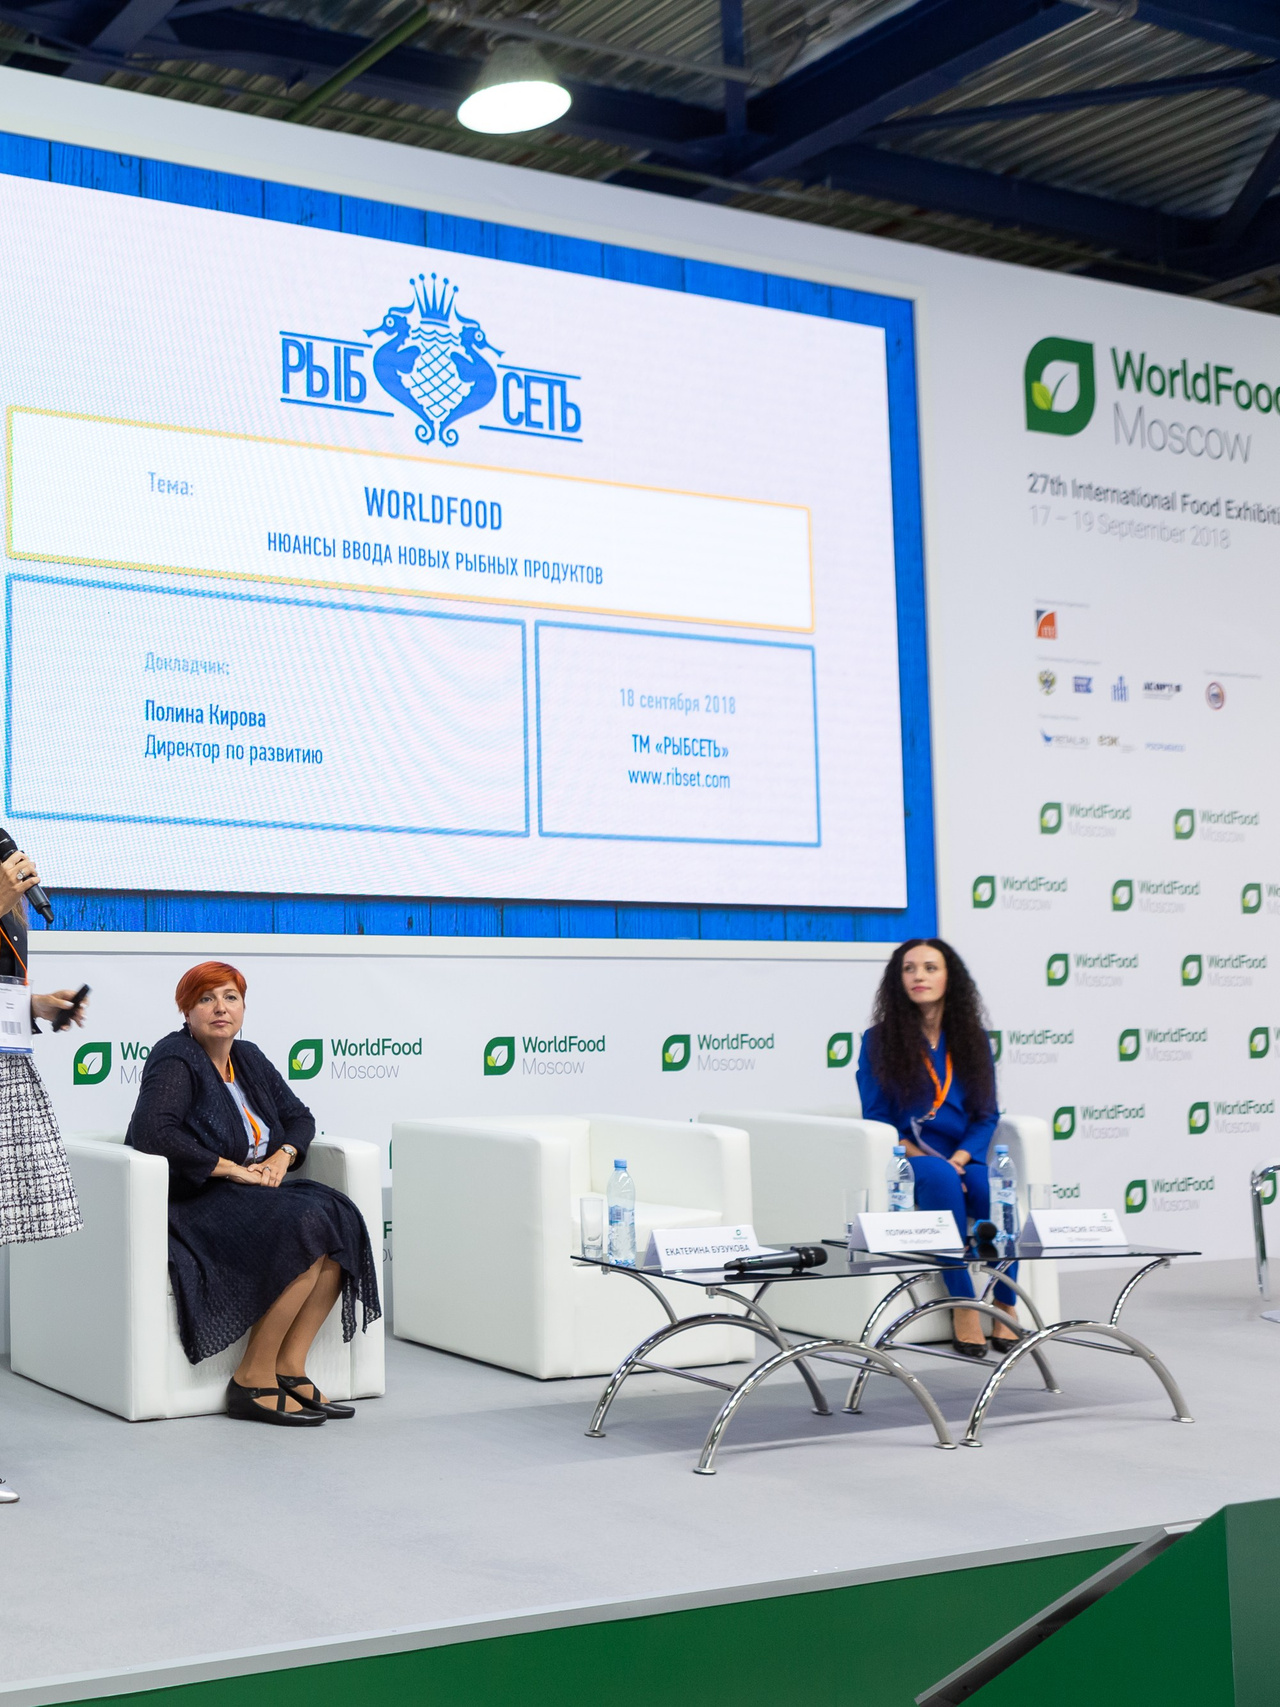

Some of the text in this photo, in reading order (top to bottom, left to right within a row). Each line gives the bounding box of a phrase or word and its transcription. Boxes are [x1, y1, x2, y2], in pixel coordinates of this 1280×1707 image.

[282, 338, 581, 433] РЫБ СЕТЬ
[1114, 402, 1252, 464] Moscow
[148, 471, 194, 496] Тема:
[364, 487, 502, 530] WORLDFOOD
[1027, 472, 1280, 525] 27th International Food Exhibiti
[1030, 505, 1050, 526] 17
[1074, 510, 1094, 532] 19
[1097, 512, 1186, 543] September
[1191, 524, 1230, 549] 2018
[267, 532, 603, 585] НЮАНСЫ ВВОДА НОВЫХ РЫБНЫХ ПРОДУКТОВ
[145, 651, 230, 675] Докладчик:
[620, 688, 736, 716] 18 сентября 2018
[145, 699, 266, 730] Полина Кирова
[145, 734, 323, 766] Директор по развитию
[632, 734, 729, 758] ТМ «РЫБСЕТЬ»
[628, 767, 730, 789] www.ribset.com
[331, 1038, 422, 1056] WorldFood
[522, 1035, 605, 1053] WorldFood
[698, 1033, 775, 1051] WorldFood
[331, 1061, 400, 1080] Moscow
[522, 1057, 585, 1076] Moscow
[698, 1054, 755, 1071] Moscow
[665, 1245, 710, 1256] ЕКАТЕРИНА
